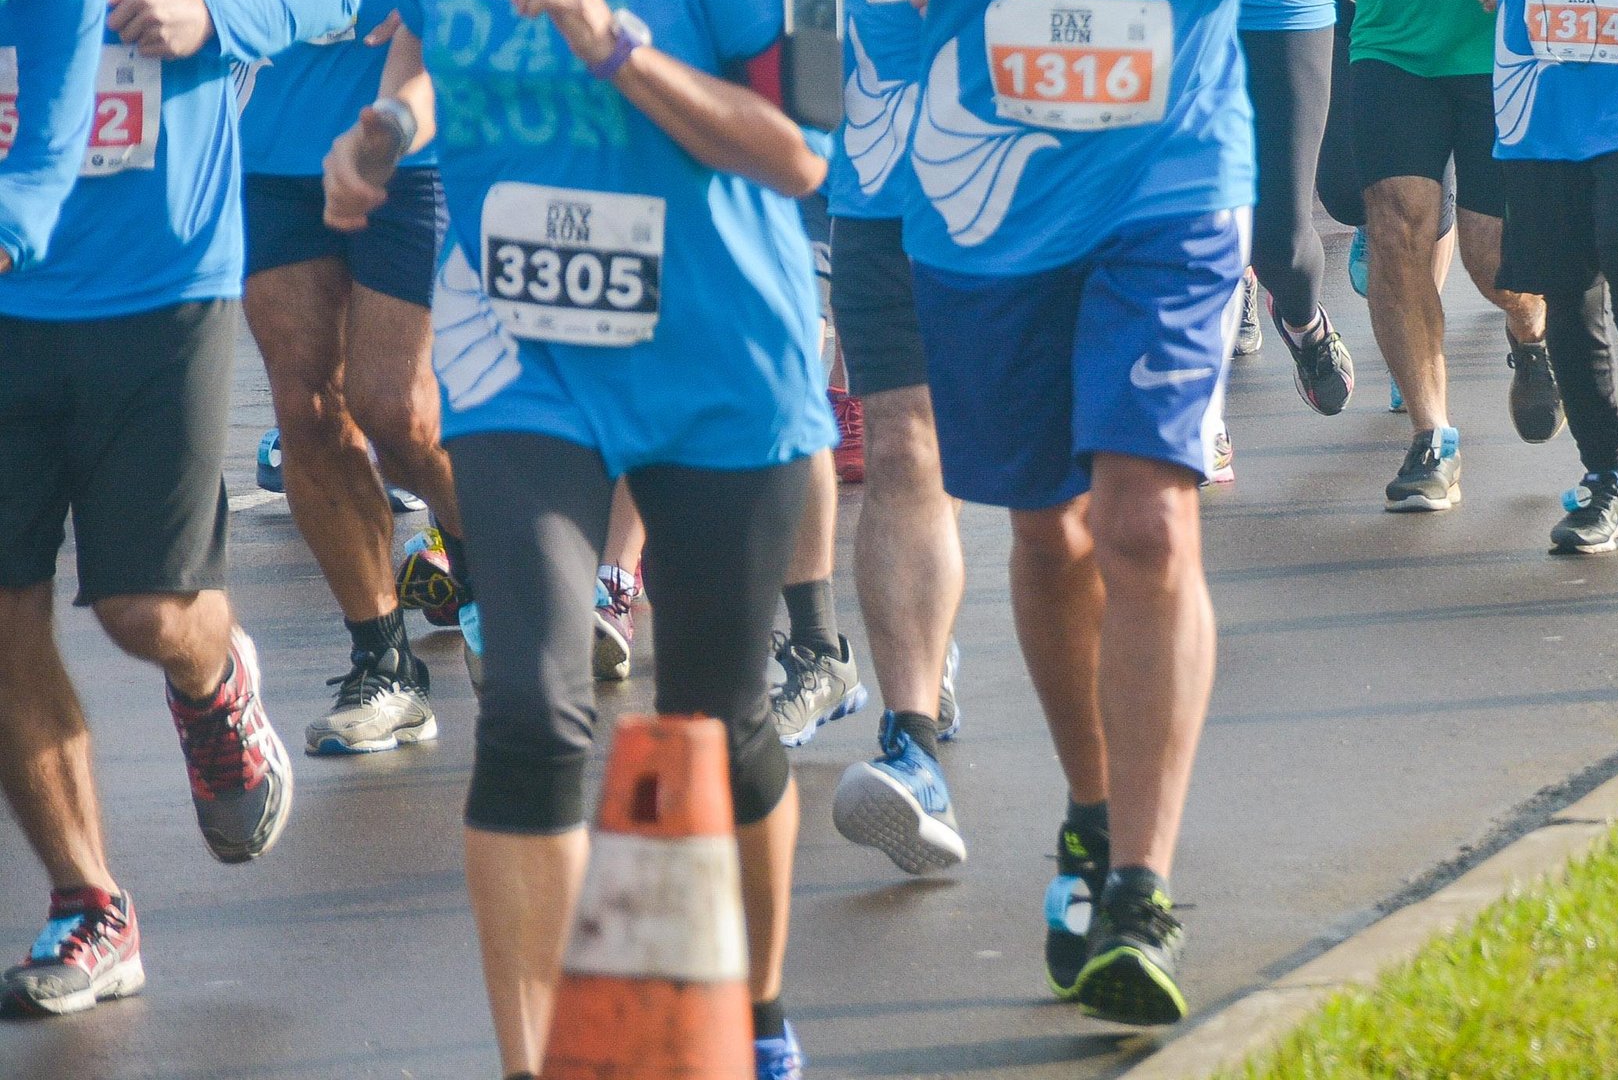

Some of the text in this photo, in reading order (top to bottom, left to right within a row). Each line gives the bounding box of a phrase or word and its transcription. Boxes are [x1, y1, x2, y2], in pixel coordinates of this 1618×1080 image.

[1050, 12, 1092, 30] DAY
[1050, 28, 1092, 44] RUN
[1002, 51, 1142, 102] 1316
[434, 72, 630, 148] RUN
[547, 203, 592, 224] DAY
[545, 221, 590, 242] RUN
[494, 245, 644, 309] 3305
